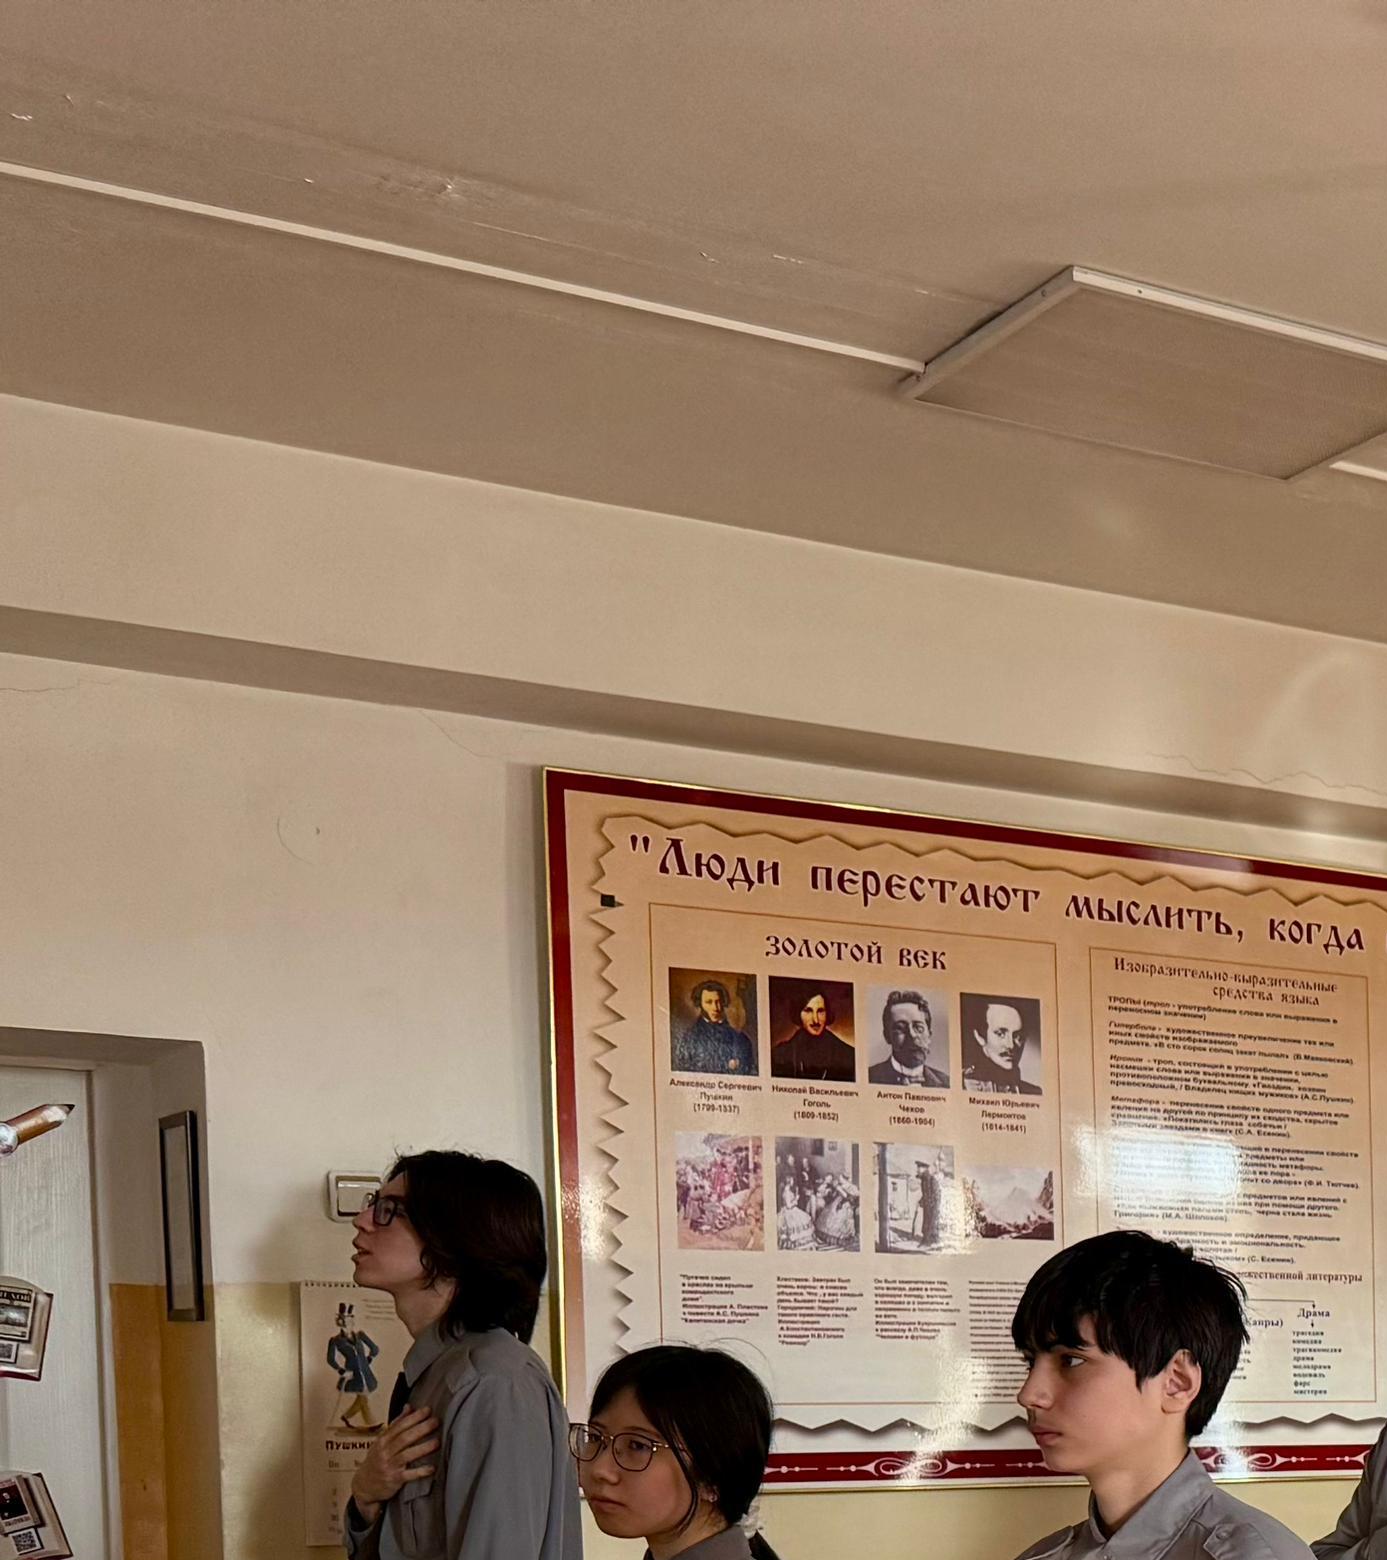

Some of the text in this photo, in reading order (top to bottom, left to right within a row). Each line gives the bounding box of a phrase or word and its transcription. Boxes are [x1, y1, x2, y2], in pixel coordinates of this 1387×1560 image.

[630, 834, 780, 893] "Люди
[810, 866, 1040, 914] перестают
[1065, 895, 1243, 942] мыслить,
[1269, 918, 1364, 956] когда
